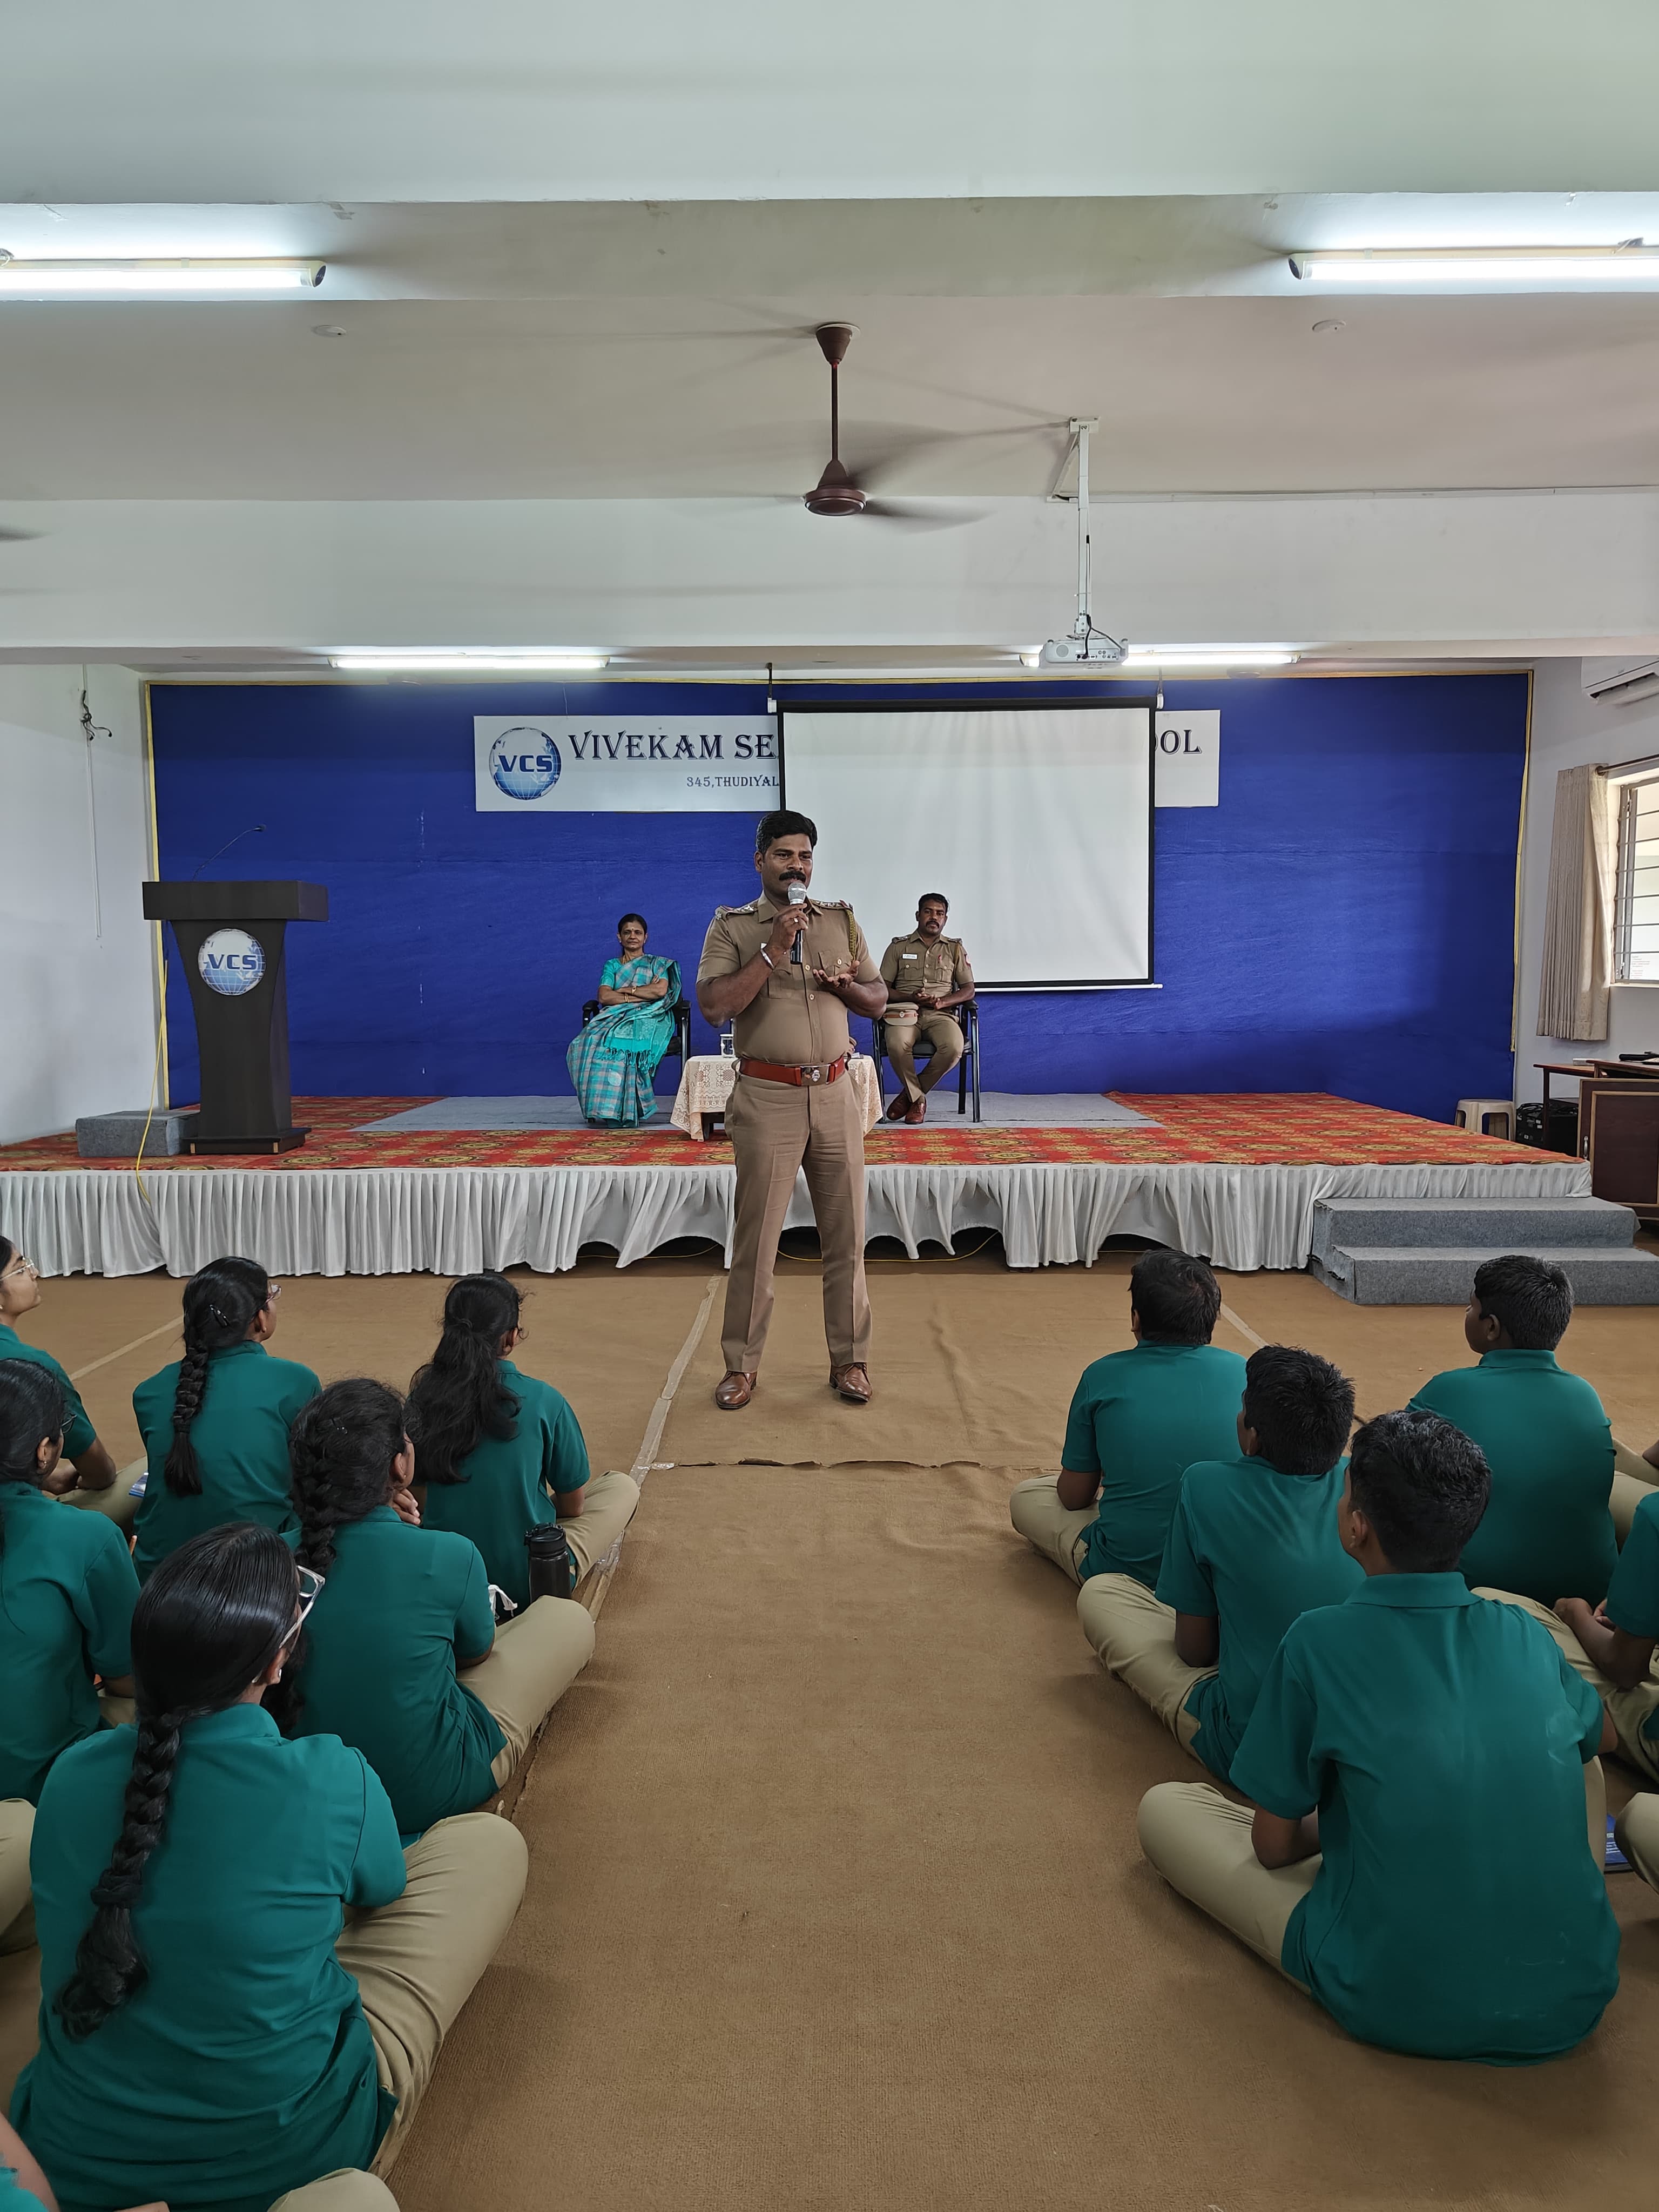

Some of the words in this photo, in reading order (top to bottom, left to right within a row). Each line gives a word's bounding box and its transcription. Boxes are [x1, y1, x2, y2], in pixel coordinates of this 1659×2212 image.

[567, 730, 724, 760] VIVEKAM
[1155, 729, 1202, 755] OL
[498, 754, 553, 773] VCS
[207, 954, 257, 970] VCS
